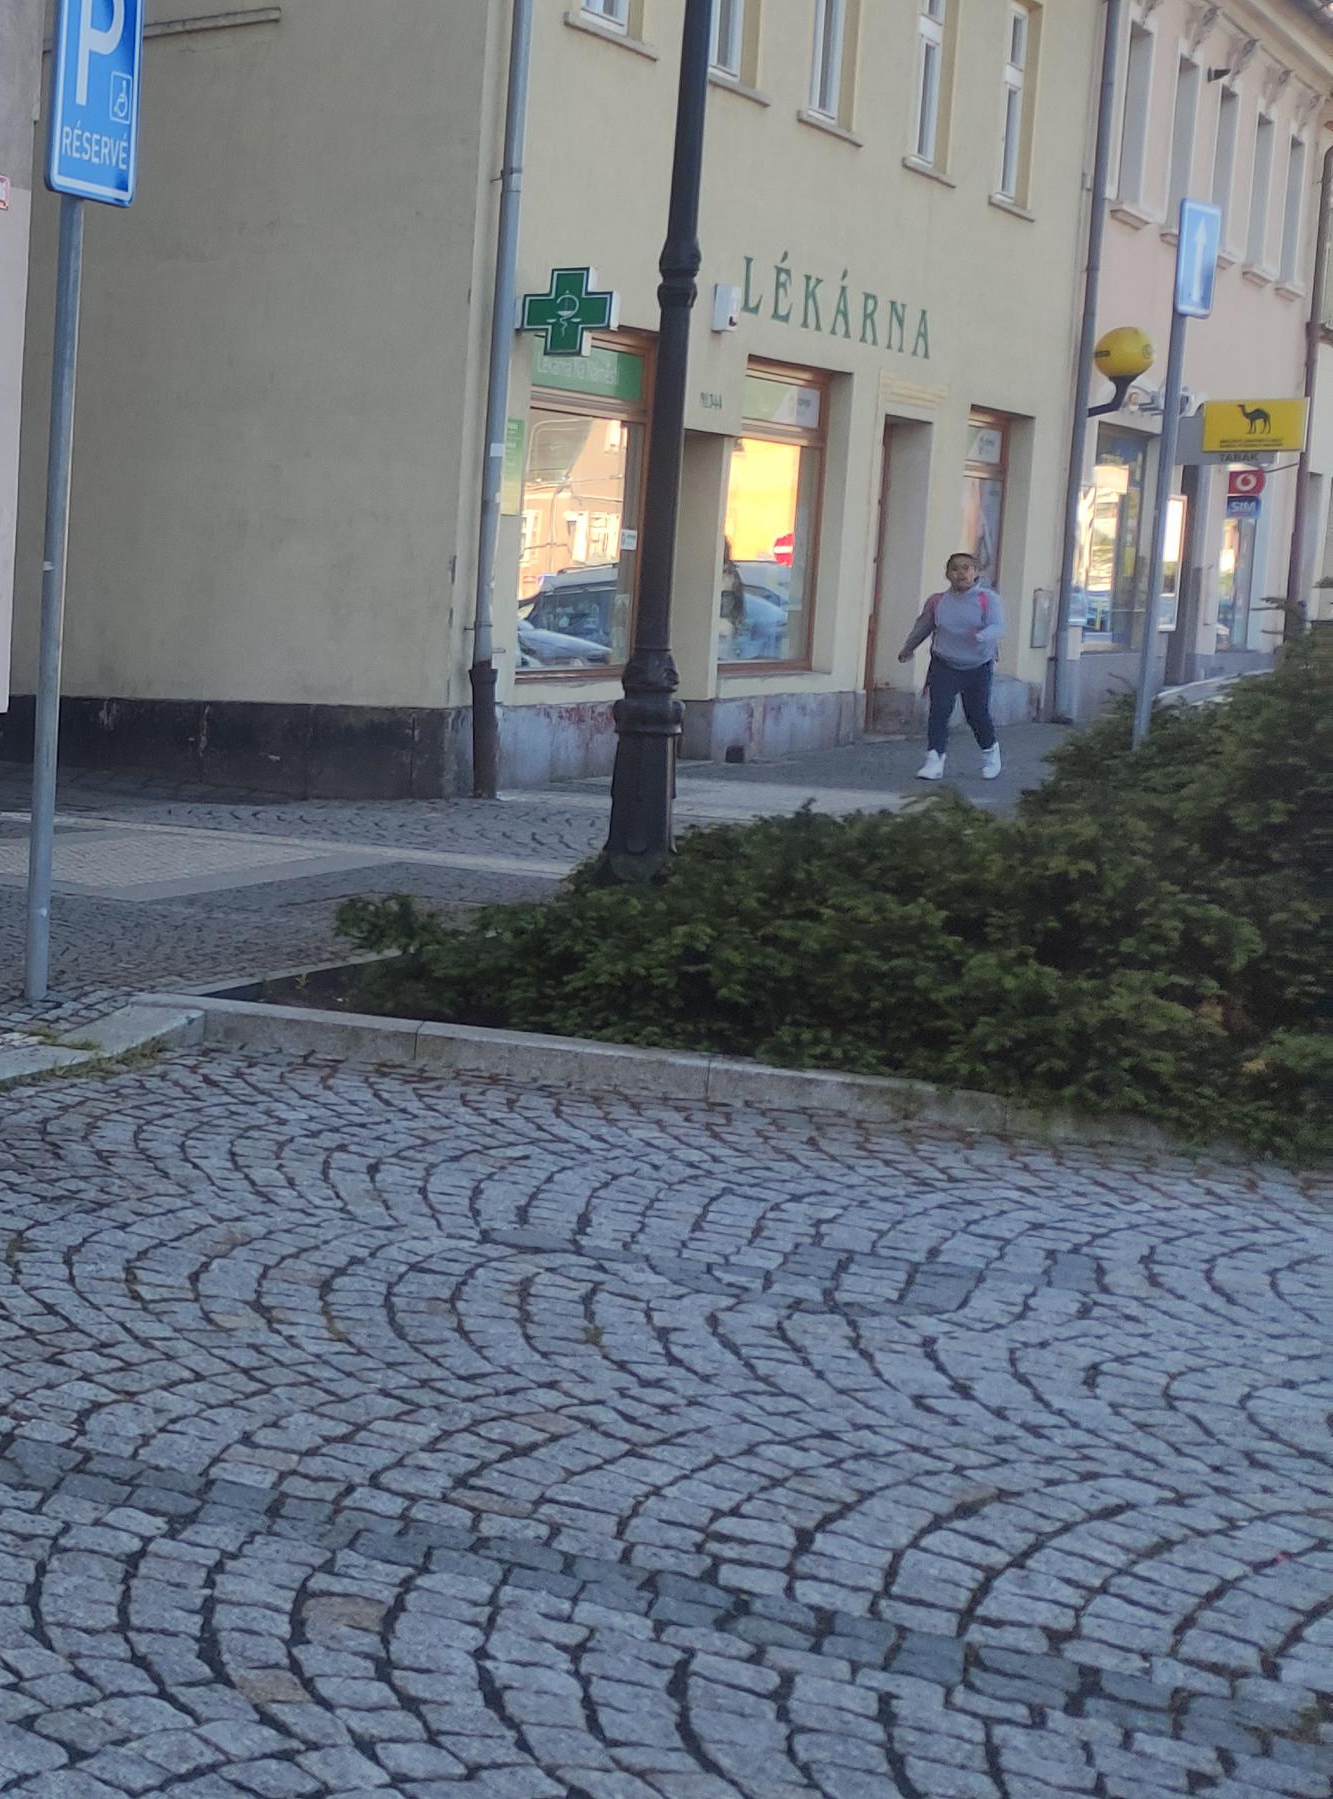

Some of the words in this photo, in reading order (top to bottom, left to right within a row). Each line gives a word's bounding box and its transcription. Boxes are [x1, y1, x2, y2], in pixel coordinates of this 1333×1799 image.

[75, 0, 125, 105] P
[62, 120, 129, 170] RÉSERVÉ
[740, 251, 931, 360] LÉKÁRNA
[1230, 501, 1256, 512] SIM
